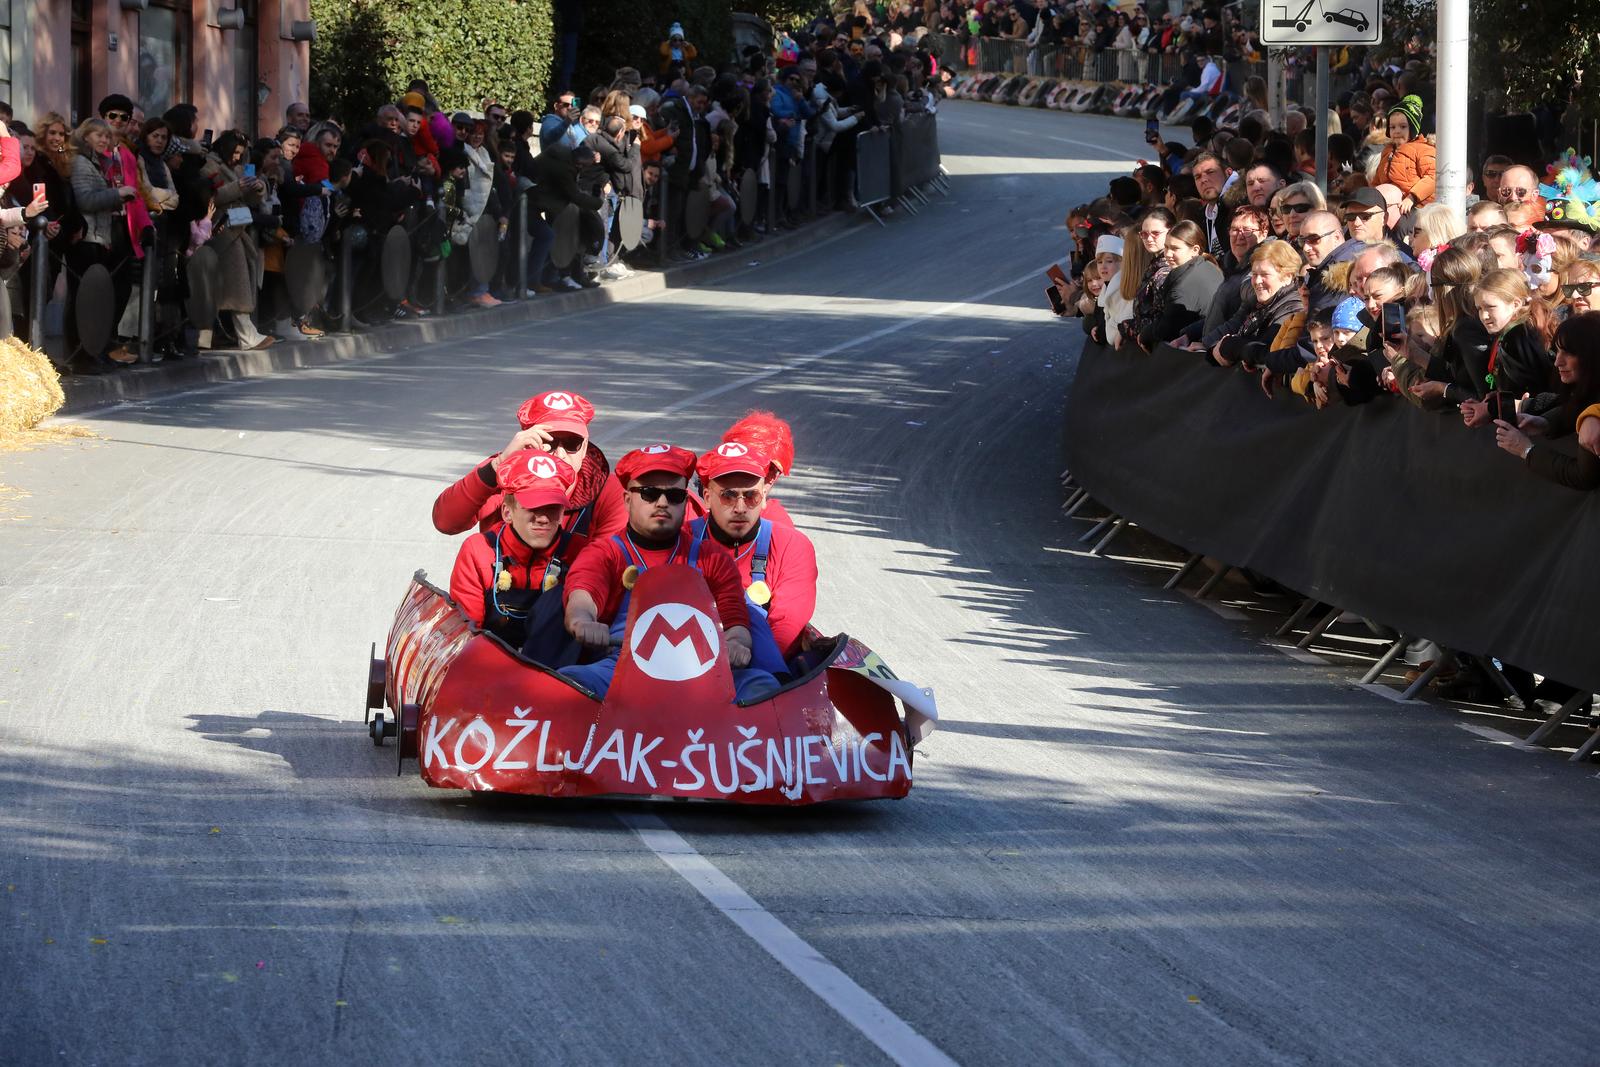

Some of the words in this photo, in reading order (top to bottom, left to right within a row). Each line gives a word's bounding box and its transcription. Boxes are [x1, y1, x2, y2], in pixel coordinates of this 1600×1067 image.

[548, 395, 571, 406] M
[722, 444, 745, 455] M
[532, 458, 554, 473] M
[635, 612, 715, 666] M
